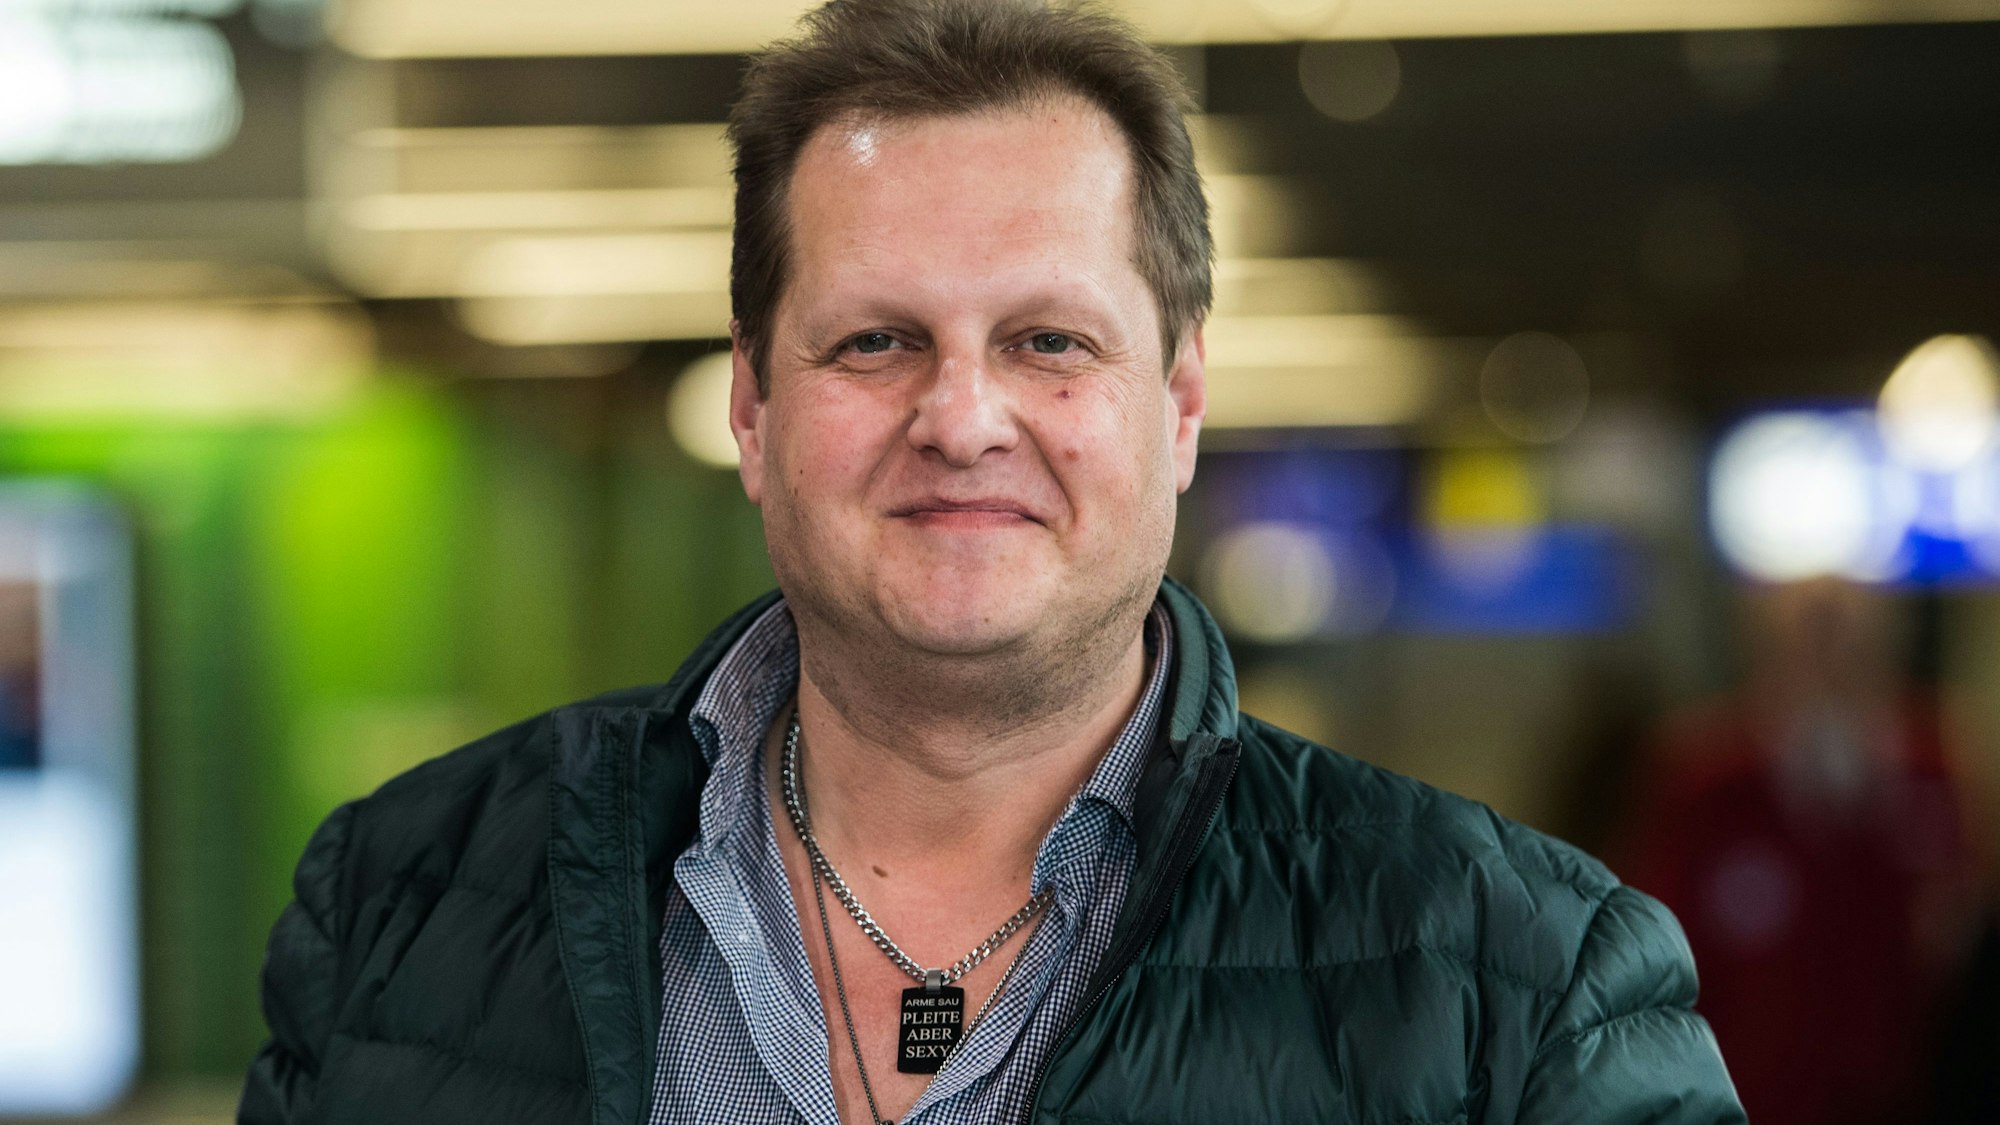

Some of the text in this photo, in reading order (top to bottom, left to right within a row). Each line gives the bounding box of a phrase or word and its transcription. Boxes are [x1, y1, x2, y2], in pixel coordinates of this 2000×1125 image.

[905, 998, 960, 1007] ARME SAU
[902, 1011, 960, 1025] PLEITE
[906, 1028, 952, 1041] ABER
[905, 1045, 951, 1058] SEXY
